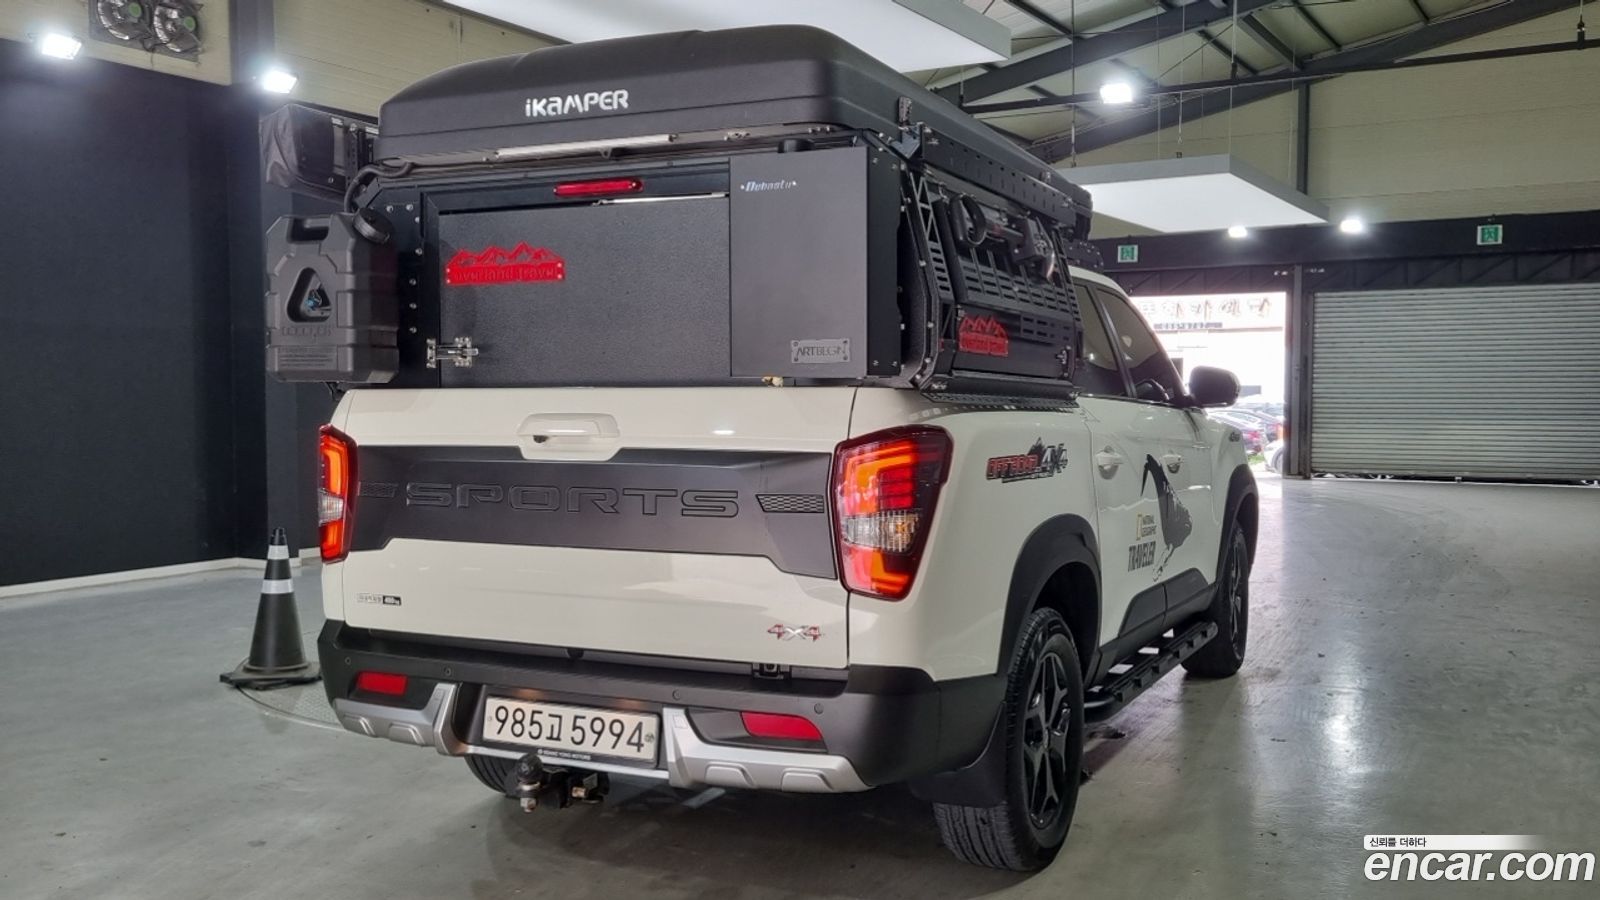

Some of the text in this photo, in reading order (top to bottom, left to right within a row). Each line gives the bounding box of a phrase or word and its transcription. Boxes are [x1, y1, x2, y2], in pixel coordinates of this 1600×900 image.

[406, 482, 739, 518] SPORTS
[1128, 541, 1156, 571] TRAVELER
[495, 705, 644, 752] 985고 5994
